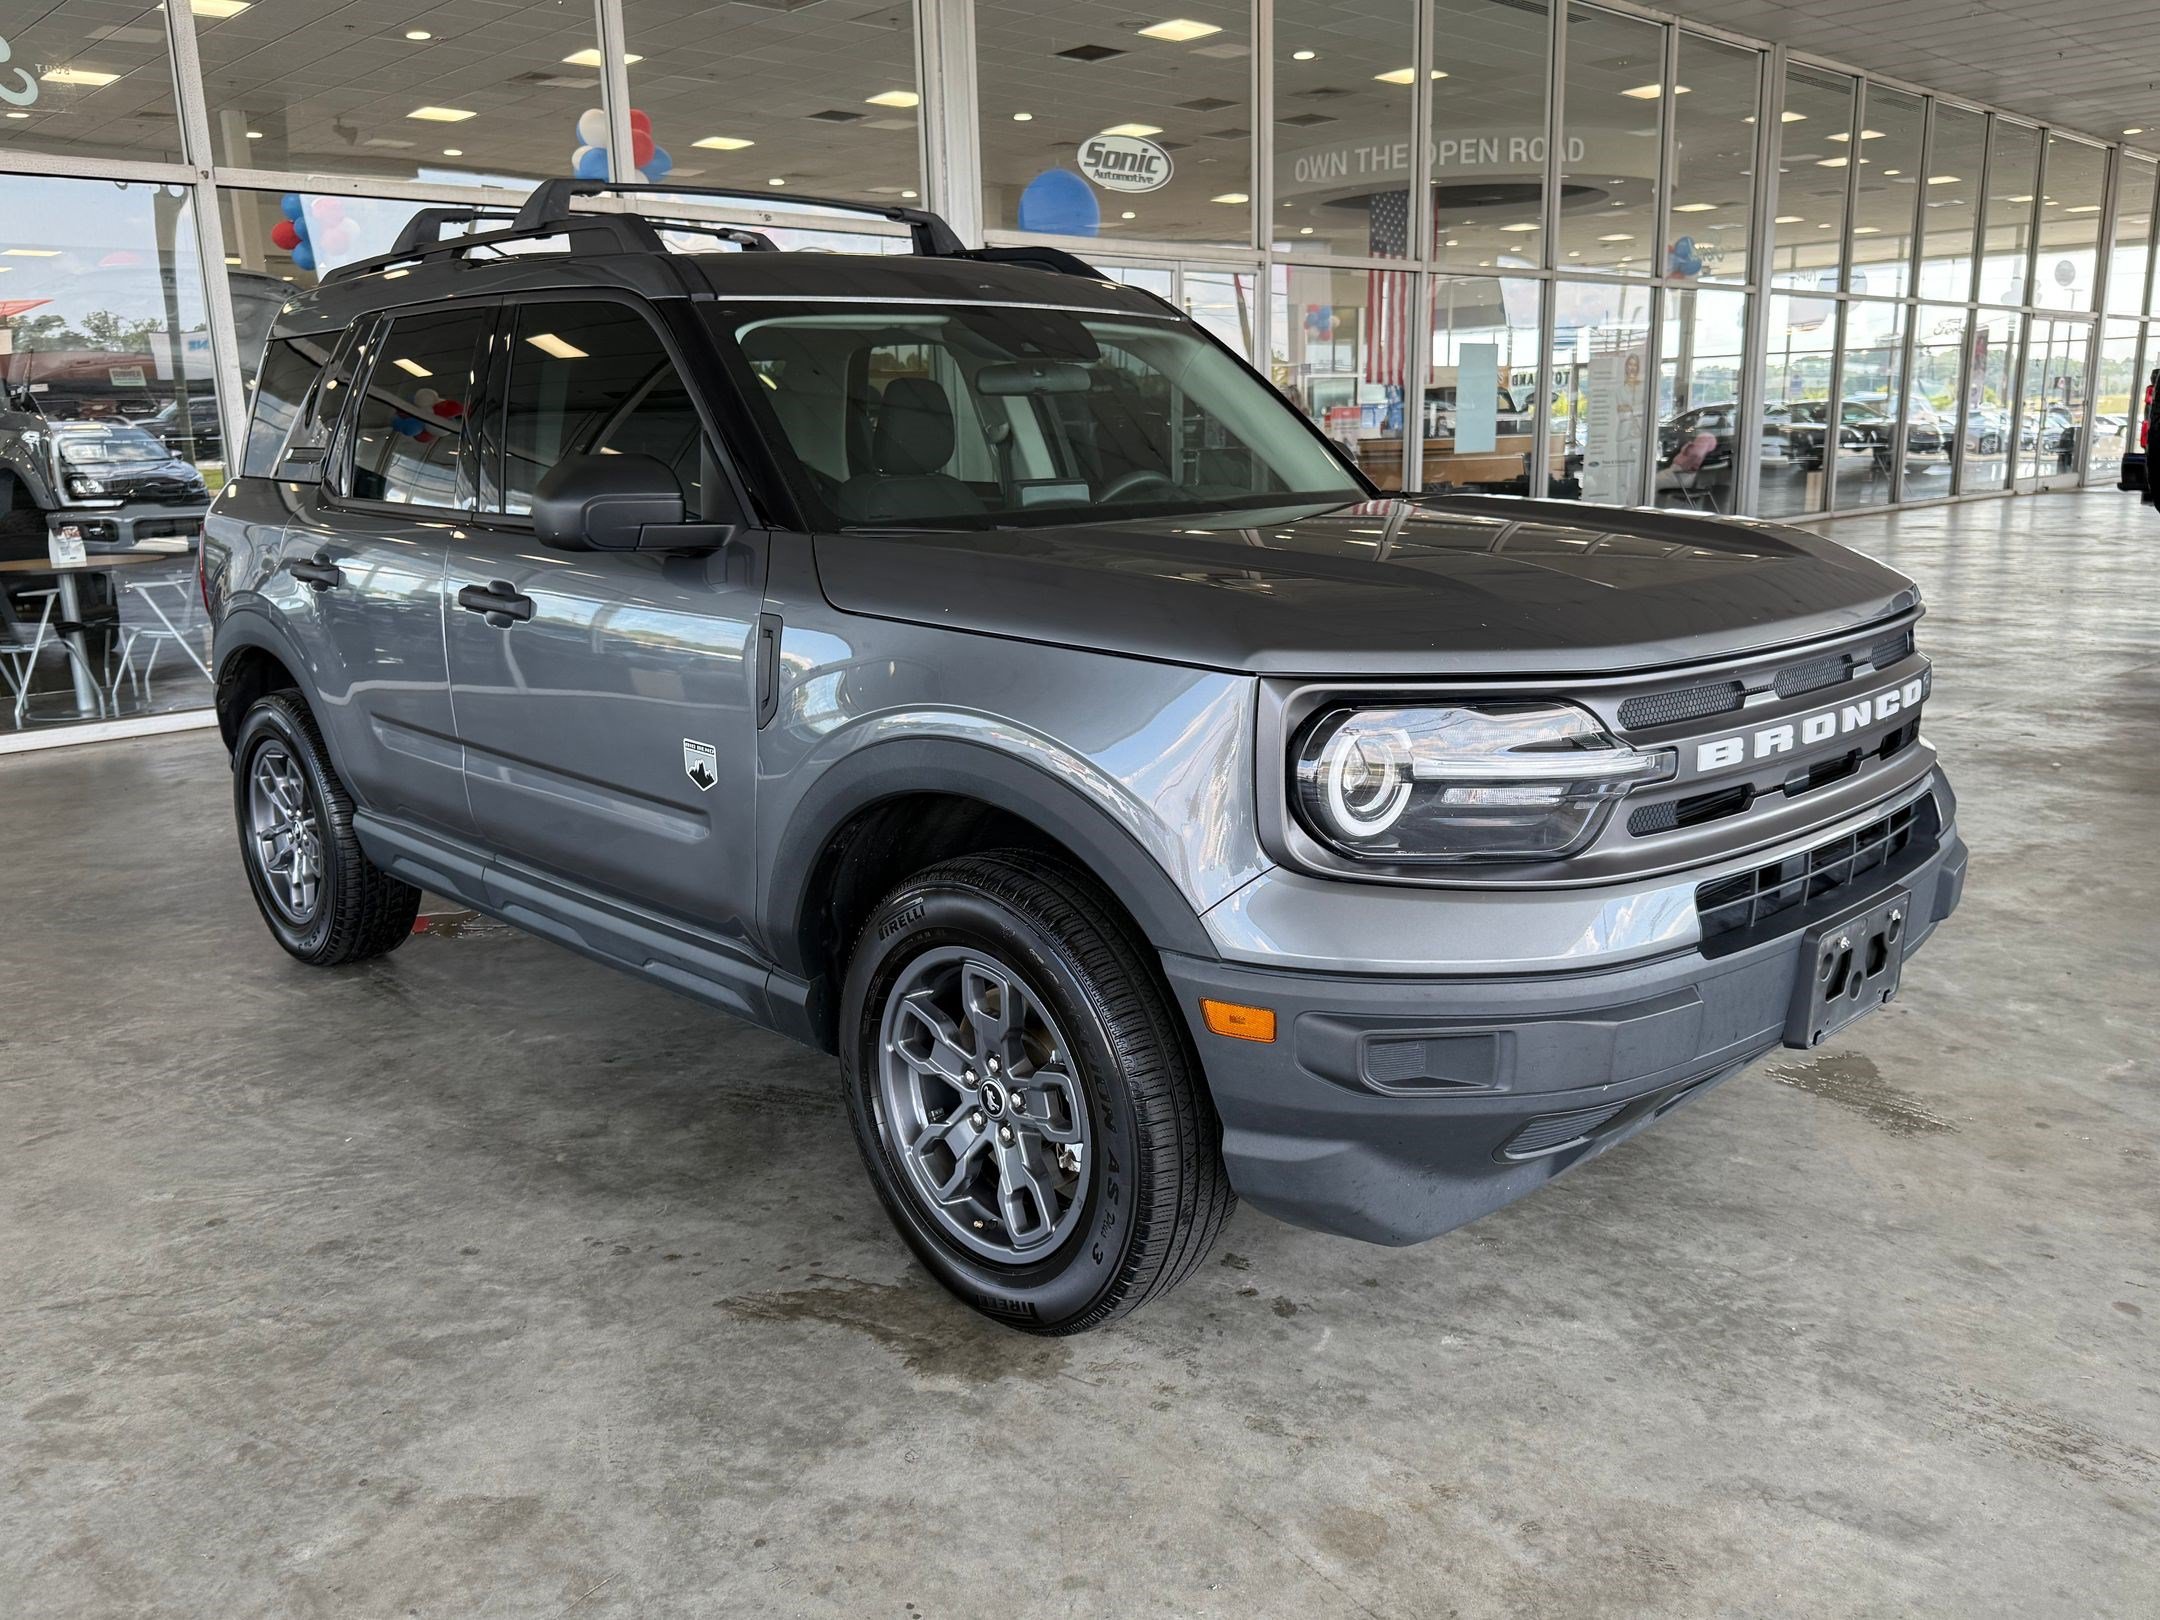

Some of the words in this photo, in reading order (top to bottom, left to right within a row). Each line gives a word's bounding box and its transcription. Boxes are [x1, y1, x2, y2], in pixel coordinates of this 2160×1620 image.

[1084, 142, 1161, 175] Sonic
[1094, 169, 1154, 184] Automotive
[1294, 150, 1348, 182] OWN
[1354, 143, 1409, 173] THE
[1697, 678, 1922, 772] BRONCO
[879, 904, 926, 941] PIRELLI
[1107, 1146, 1119, 1206] AS
[1092, 1242, 1104, 1266] 3
